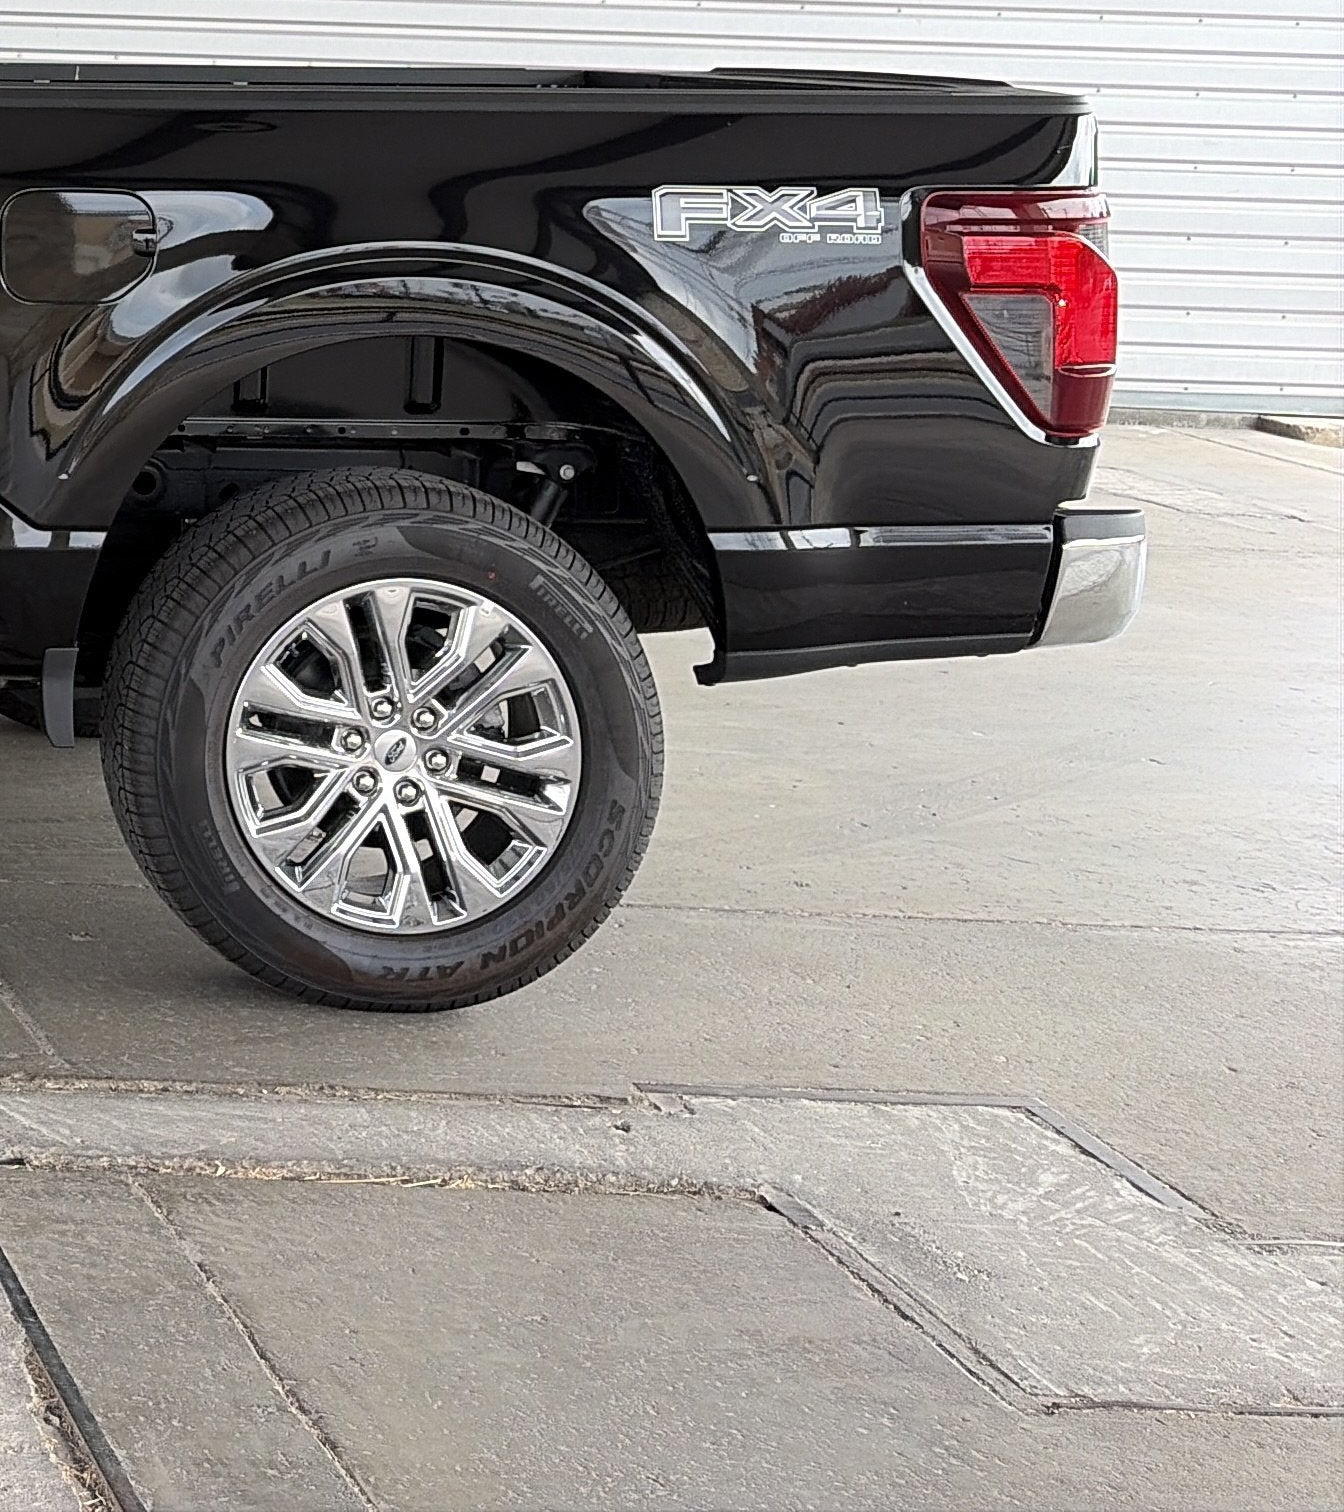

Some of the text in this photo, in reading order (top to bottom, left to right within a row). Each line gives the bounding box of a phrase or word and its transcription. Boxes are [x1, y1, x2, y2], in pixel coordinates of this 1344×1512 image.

[651, 184, 885, 241] FX4
[779, 232, 882, 245] OFF ROAD
[210, 549, 332, 669] PIRELLI
